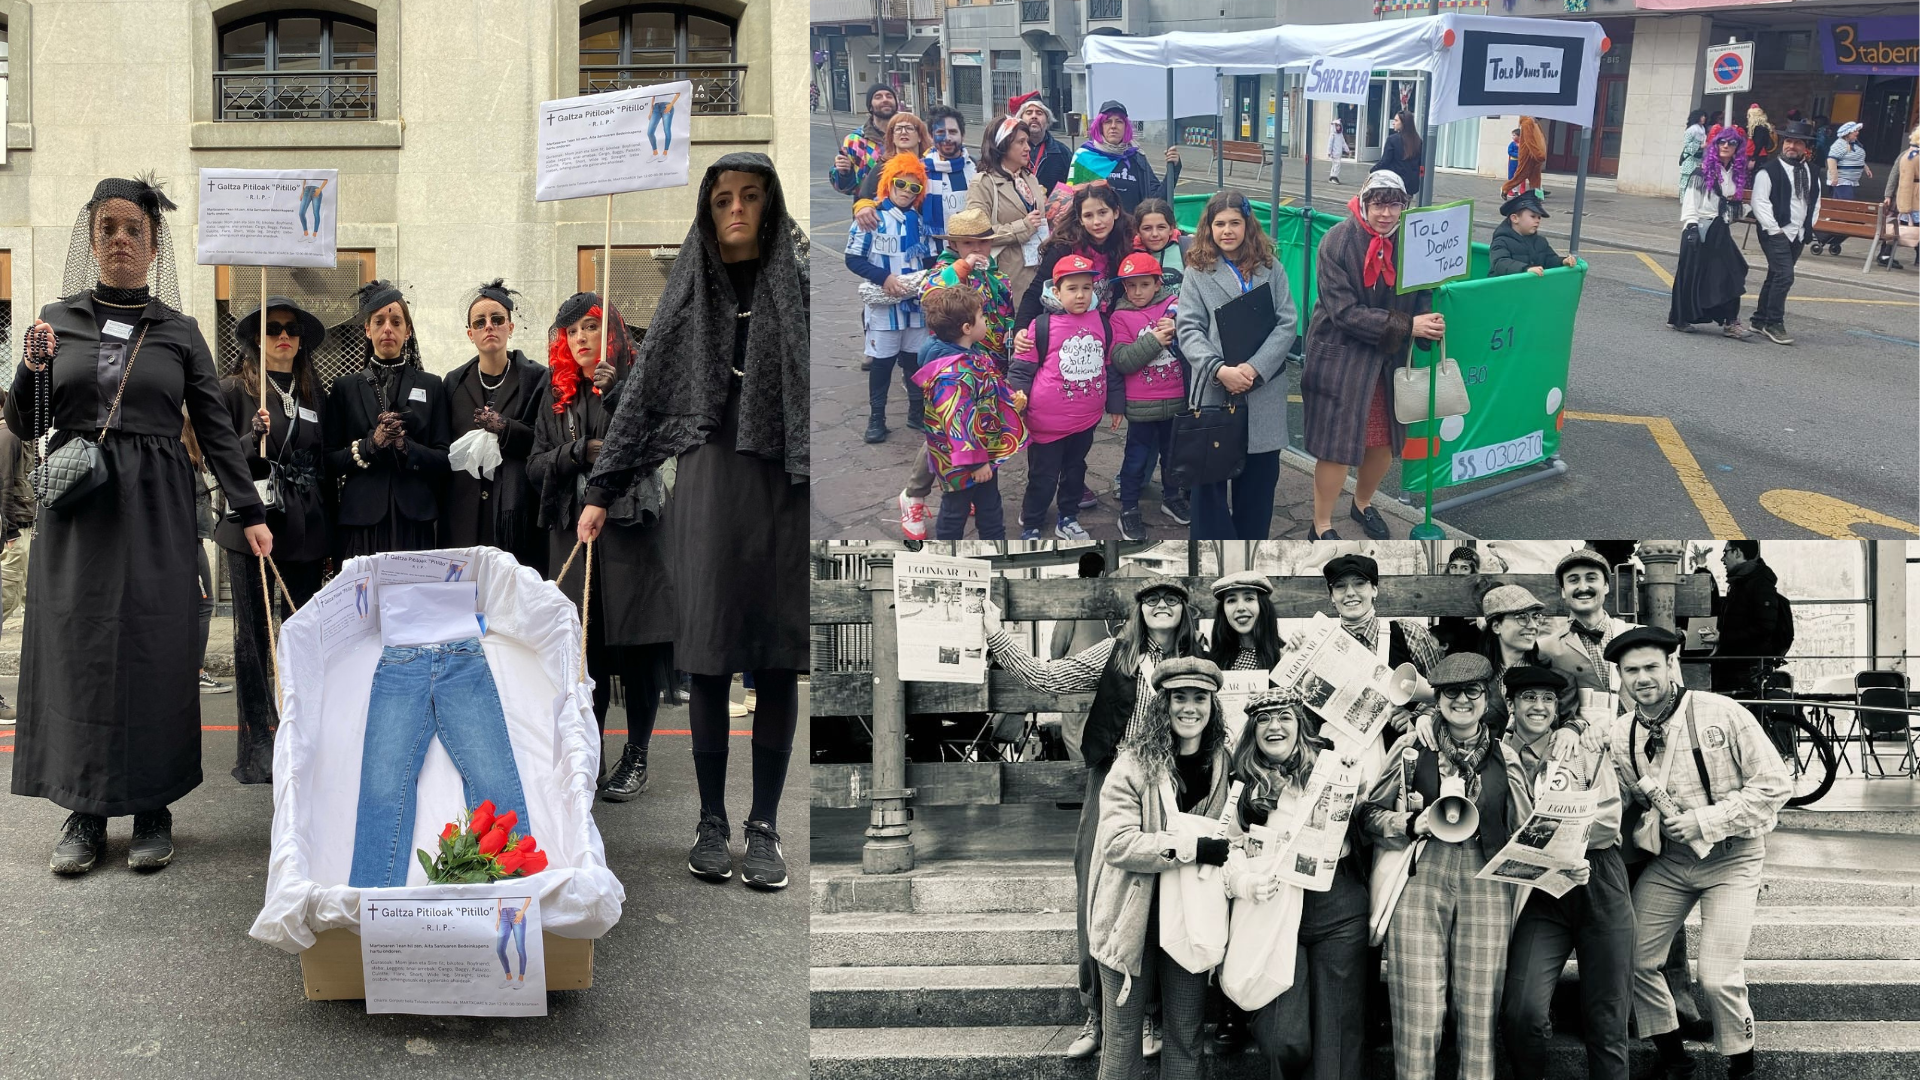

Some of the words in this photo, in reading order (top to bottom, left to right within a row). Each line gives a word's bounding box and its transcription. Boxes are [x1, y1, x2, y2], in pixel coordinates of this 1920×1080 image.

[1836, 25, 1857, 62] 3
[1306, 59, 1370, 95] SARRERA
[557, 113, 583, 122] Galtza
[585, 107, 615, 118] Pitiloak
[243, 183, 270, 191] Pitiloak
[1410, 219, 1449, 238] TOLO
[1426, 236, 1459, 257] DONOS
[1435, 256, 1464, 273] TOLO
[1491, 326, 1514, 351] 51
[381, 907, 413, 917] Galtza
[416, 907, 454, 917] Pitiloak
